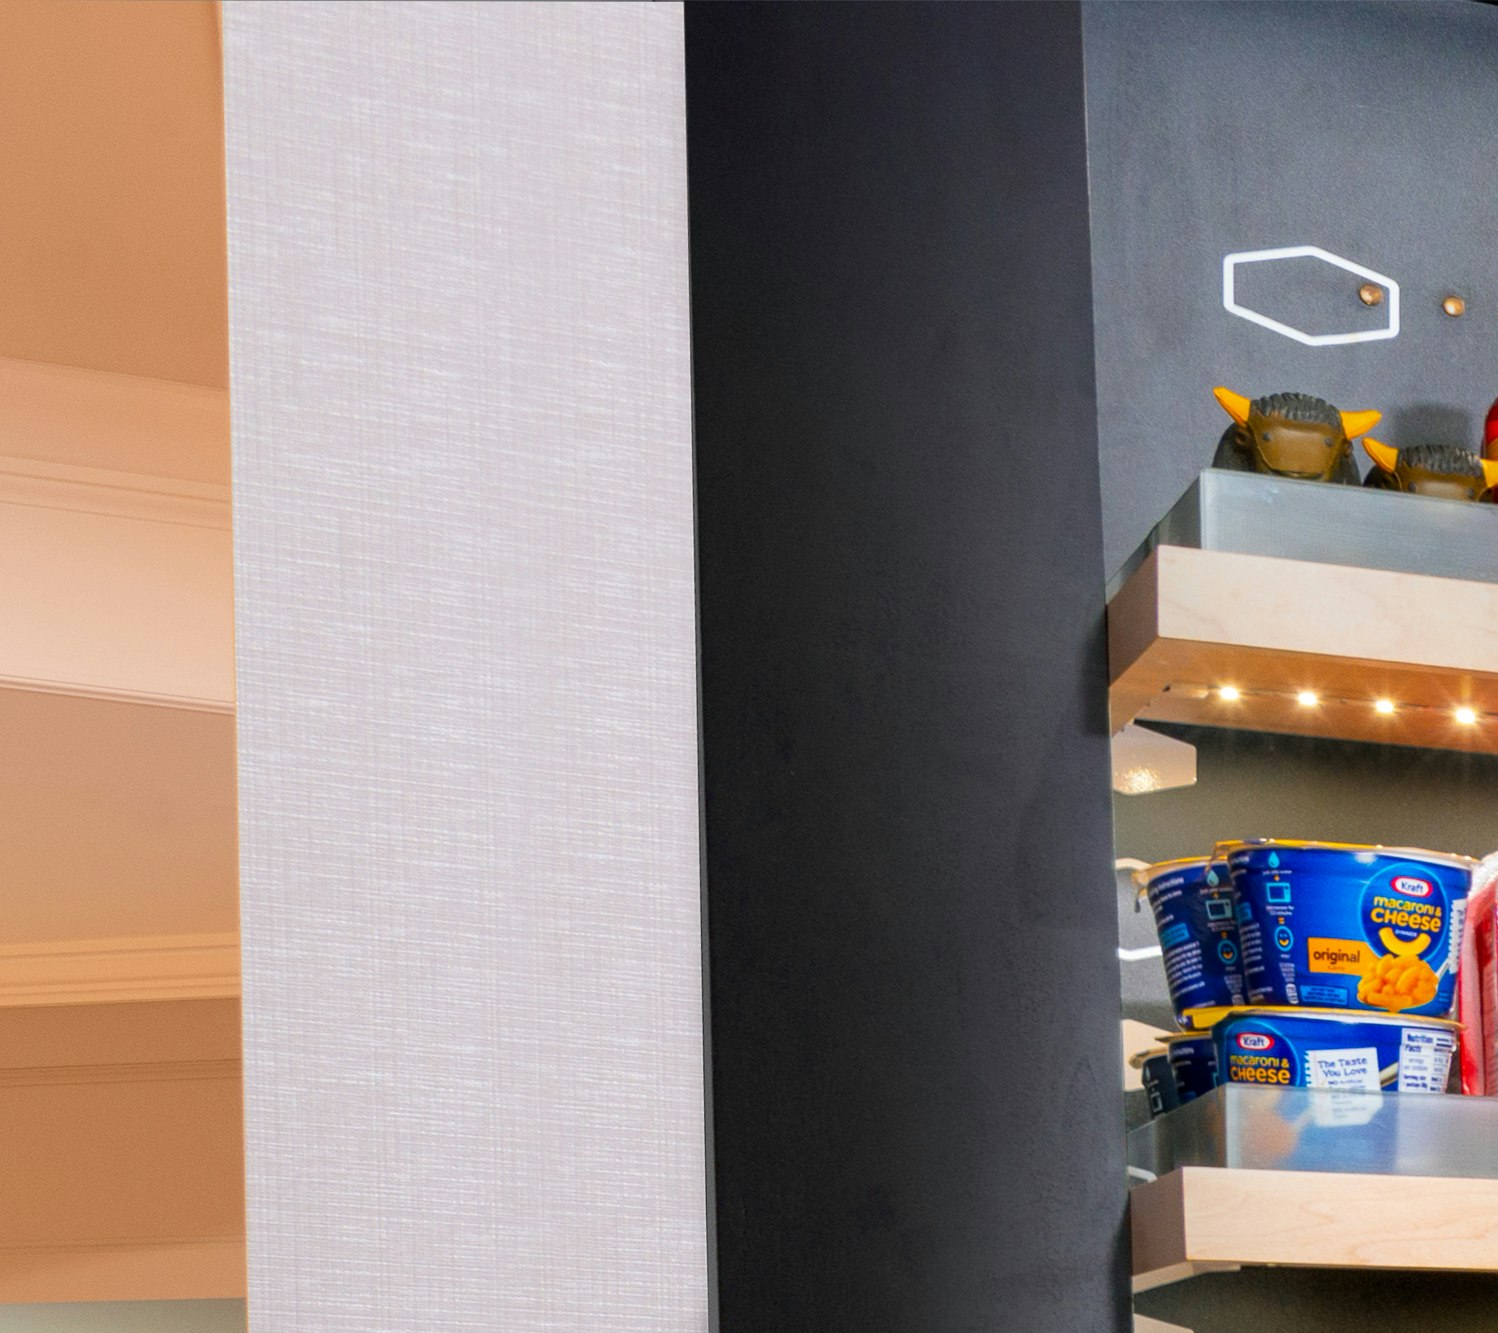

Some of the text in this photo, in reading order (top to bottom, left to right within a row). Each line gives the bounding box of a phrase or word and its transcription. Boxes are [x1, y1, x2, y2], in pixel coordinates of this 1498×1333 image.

[1400, 879, 1426, 894] Kraft
[1372, 895, 1434, 917] macaroni
[1312, 948, 1361, 965] original
[1242, 1035, 1265, 1048] Kraft
[1229, 1054, 1280, 1068] macaroni
[1317, 1056, 1368, 1070] The Taste
[1322, 1065, 1369, 1078] You Love
